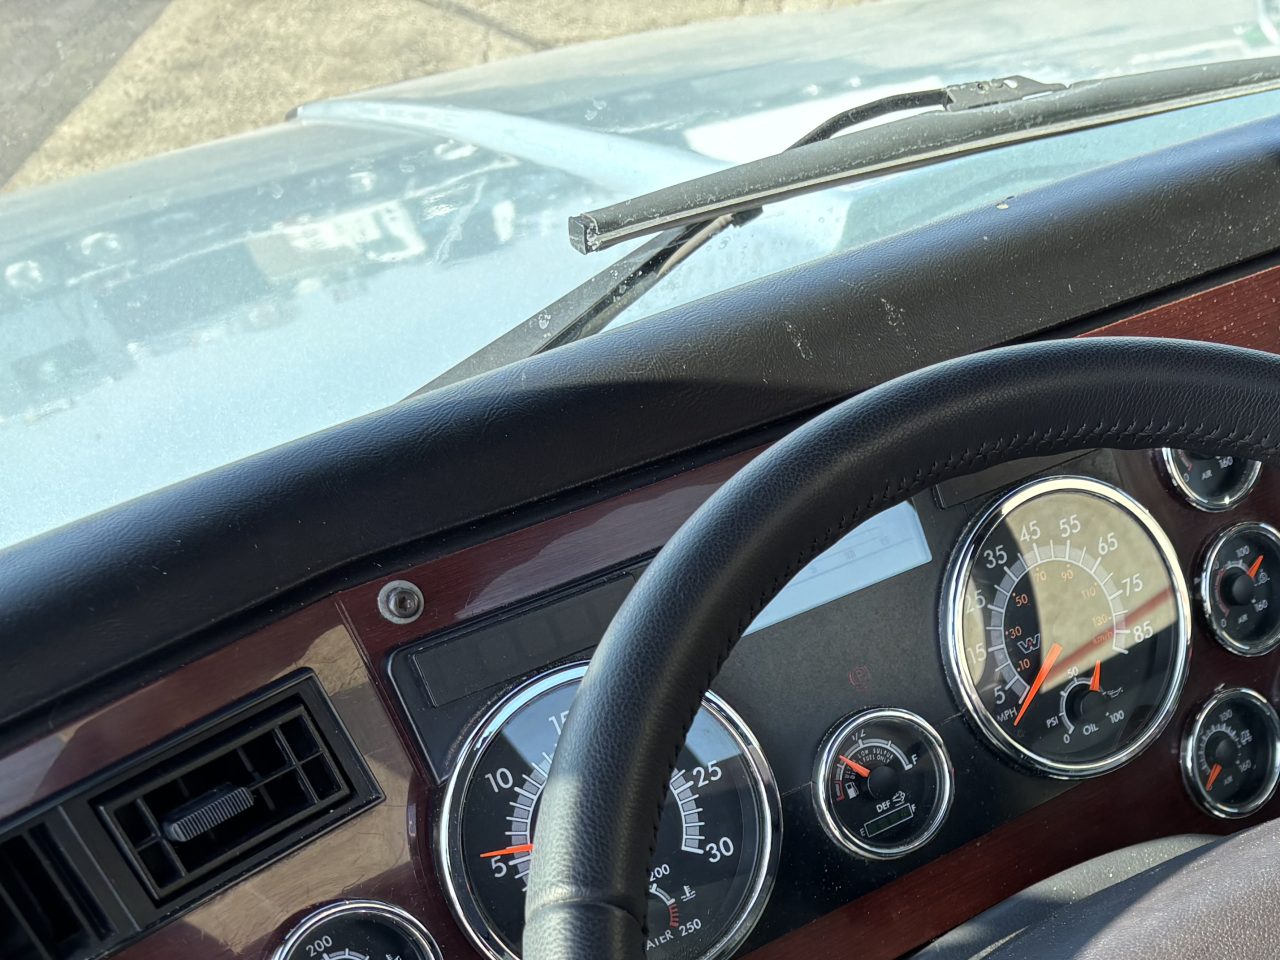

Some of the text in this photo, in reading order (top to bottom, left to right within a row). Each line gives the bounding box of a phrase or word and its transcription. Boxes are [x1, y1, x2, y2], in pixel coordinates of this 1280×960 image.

[1020, 521, 1041, 542] 45
[1059, 514, 1081, 537] 55
[1098, 532, 1119, 555] 65
[983, 545, 1007, 568] 35
[1121, 573, 1143, 597] 75
[965, 590, 986, 613] 25
[1015, 594, 1028, 607] 50
[1009, 626, 1022, 639] 30
[1133, 620, 1154, 643] 85
[967, 643, 987, 665] 15
[1019, 658, 1031, 671] 10
[1067, 666, 1079, 679] 50
[994, 688, 1006, 704] 5
[997, 707, 1018, 723] MPH
[1046, 716, 1059, 729] PSI
[1110, 710, 1125, 723] 100
[1063, 734, 1070, 744] 0
[1083, 724, 1100, 736] OIL
[911, 753, 918, 765] F
[484, 768, 513, 793] 10
[692, 760, 722, 787] 25
[876, 800, 891, 813] DEF
[911, 804, 917, 813] F
[705, 836, 734, 863] 30
[491, 856, 507, 877] 5
[679, 918, 701, 936] 250
[306, 935, 333, 957] 200
